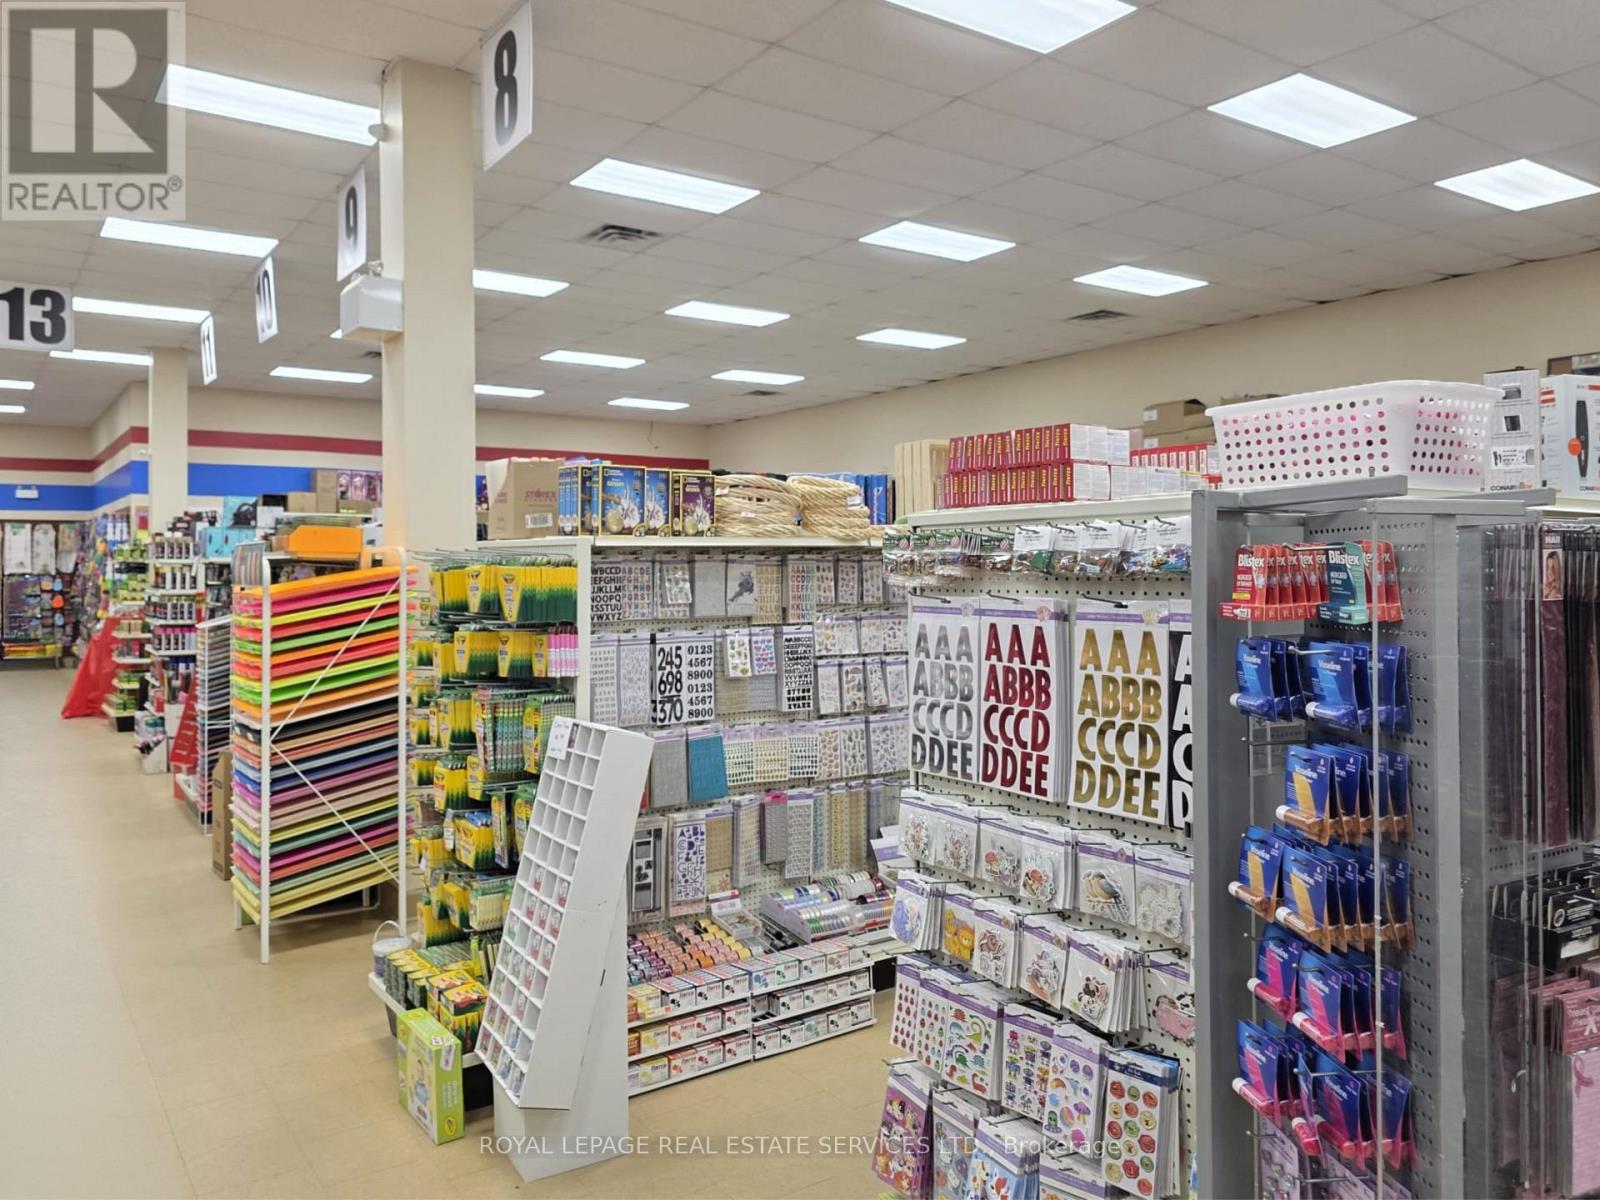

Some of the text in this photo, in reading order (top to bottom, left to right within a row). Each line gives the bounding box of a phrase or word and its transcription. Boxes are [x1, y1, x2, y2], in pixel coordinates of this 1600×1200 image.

[494, 30, 518, 146] 8
[344, 186, 358, 252] 9
[0, 287, 66, 345] 13
[256, 269, 273, 332] 10
[202, 326, 214, 377] 11
[1238, 554, 1265, 569] Blistex
[1328, 551, 1360, 568] Blistex
[658, 646, 682, 671] 245
[687, 645, 713, 655] 0123
[687, 657, 713, 667] 4567
[658, 670, 683, 695] 698
[687, 669, 713, 680] 8900
[687, 683, 713, 693] 0123
[983, 663, 1052, 710] ABBB
[659, 698, 683, 723] 370
[687, 695, 713, 706] 4567
[687, 708, 713, 719] 8900
[912, 698, 974, 741] CCCD
[1077, 673, 1162, 724] ABBB
[983, 704, 1050, 752] CCCD
[1077, 717, 1162, 769] CCCD
[911, 734, 973, 781] DDEE
[981, 743, 1050, 797] DDEE
[1073, 760, 1161, 818] DDEE
